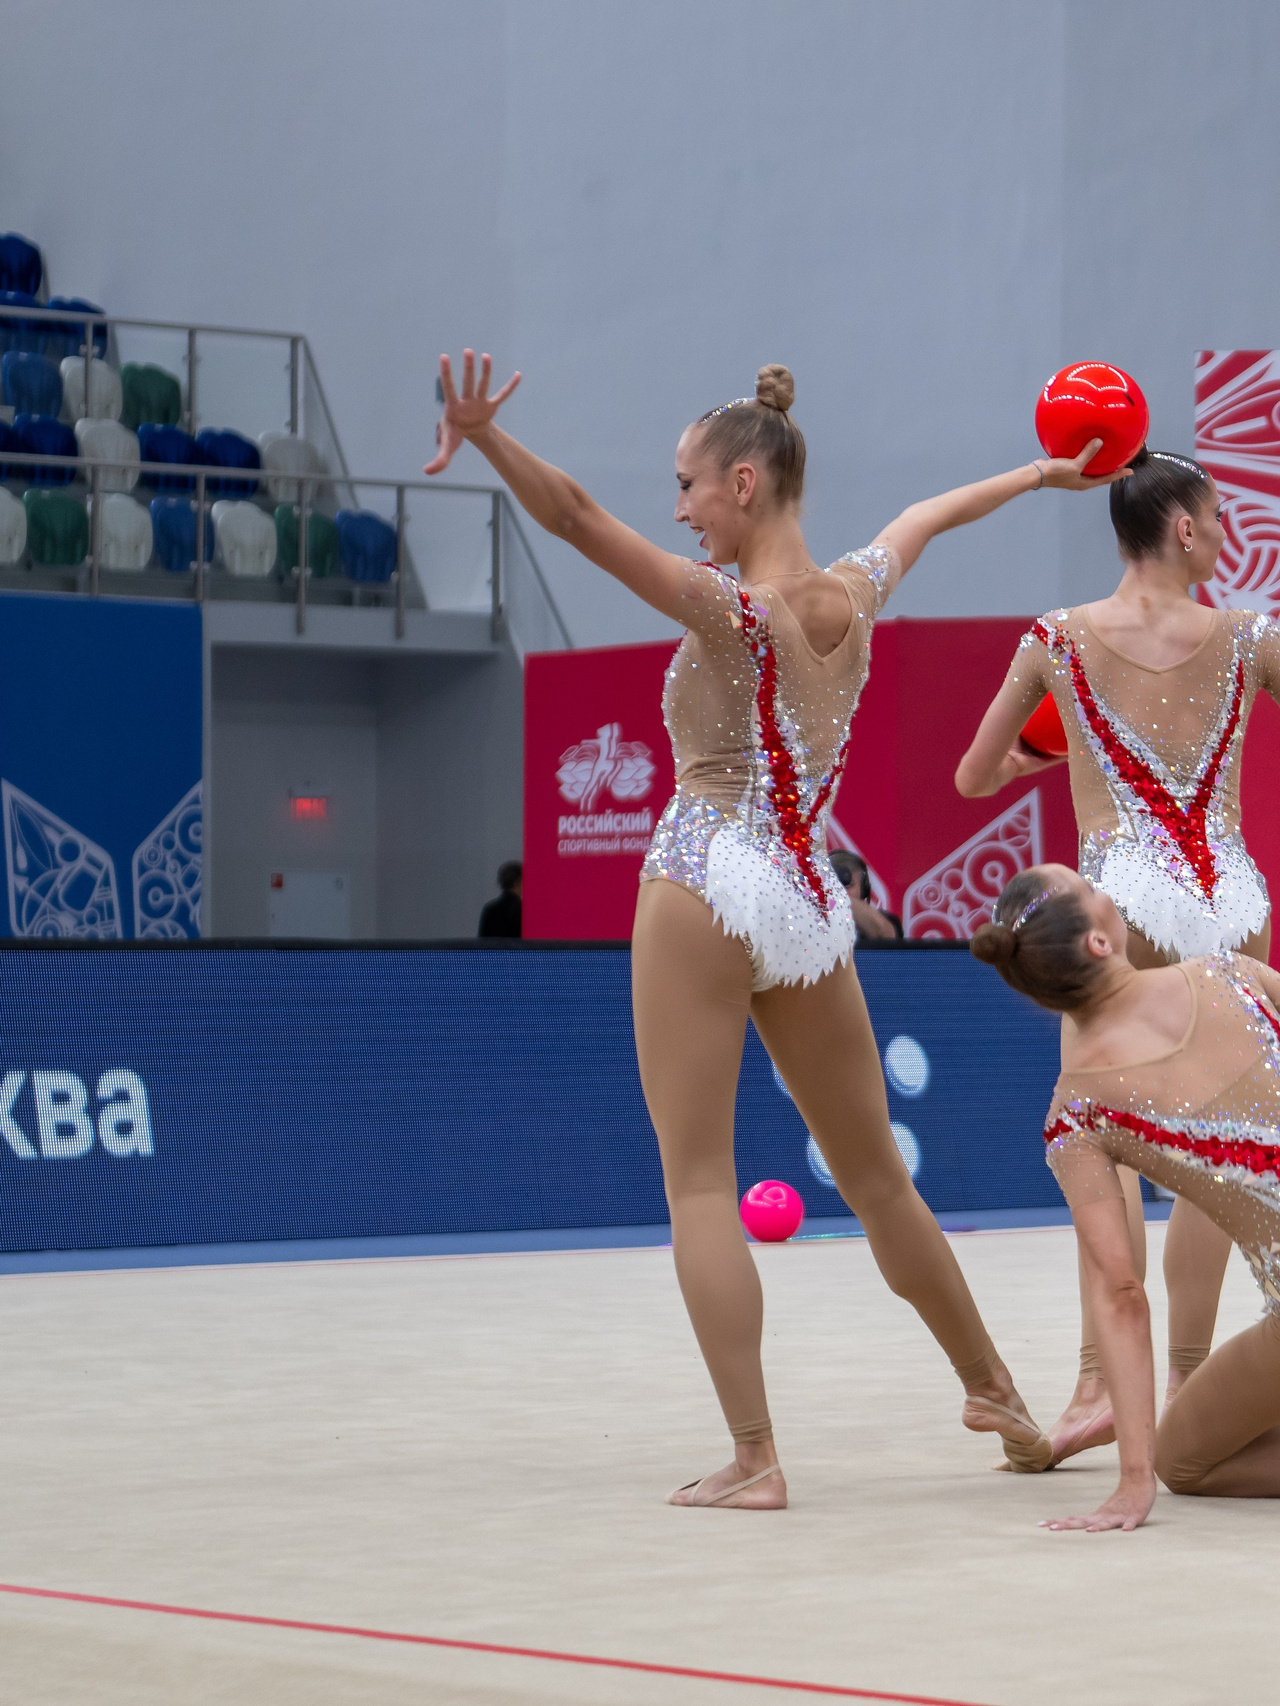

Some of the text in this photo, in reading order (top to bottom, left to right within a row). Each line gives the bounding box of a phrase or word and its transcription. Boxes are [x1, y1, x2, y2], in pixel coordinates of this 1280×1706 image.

[558, 808, 651, 834] РОССИЙСКИЙ
[558, 835, 650, 852] СПОРТИВНЫЙ ФОНД
